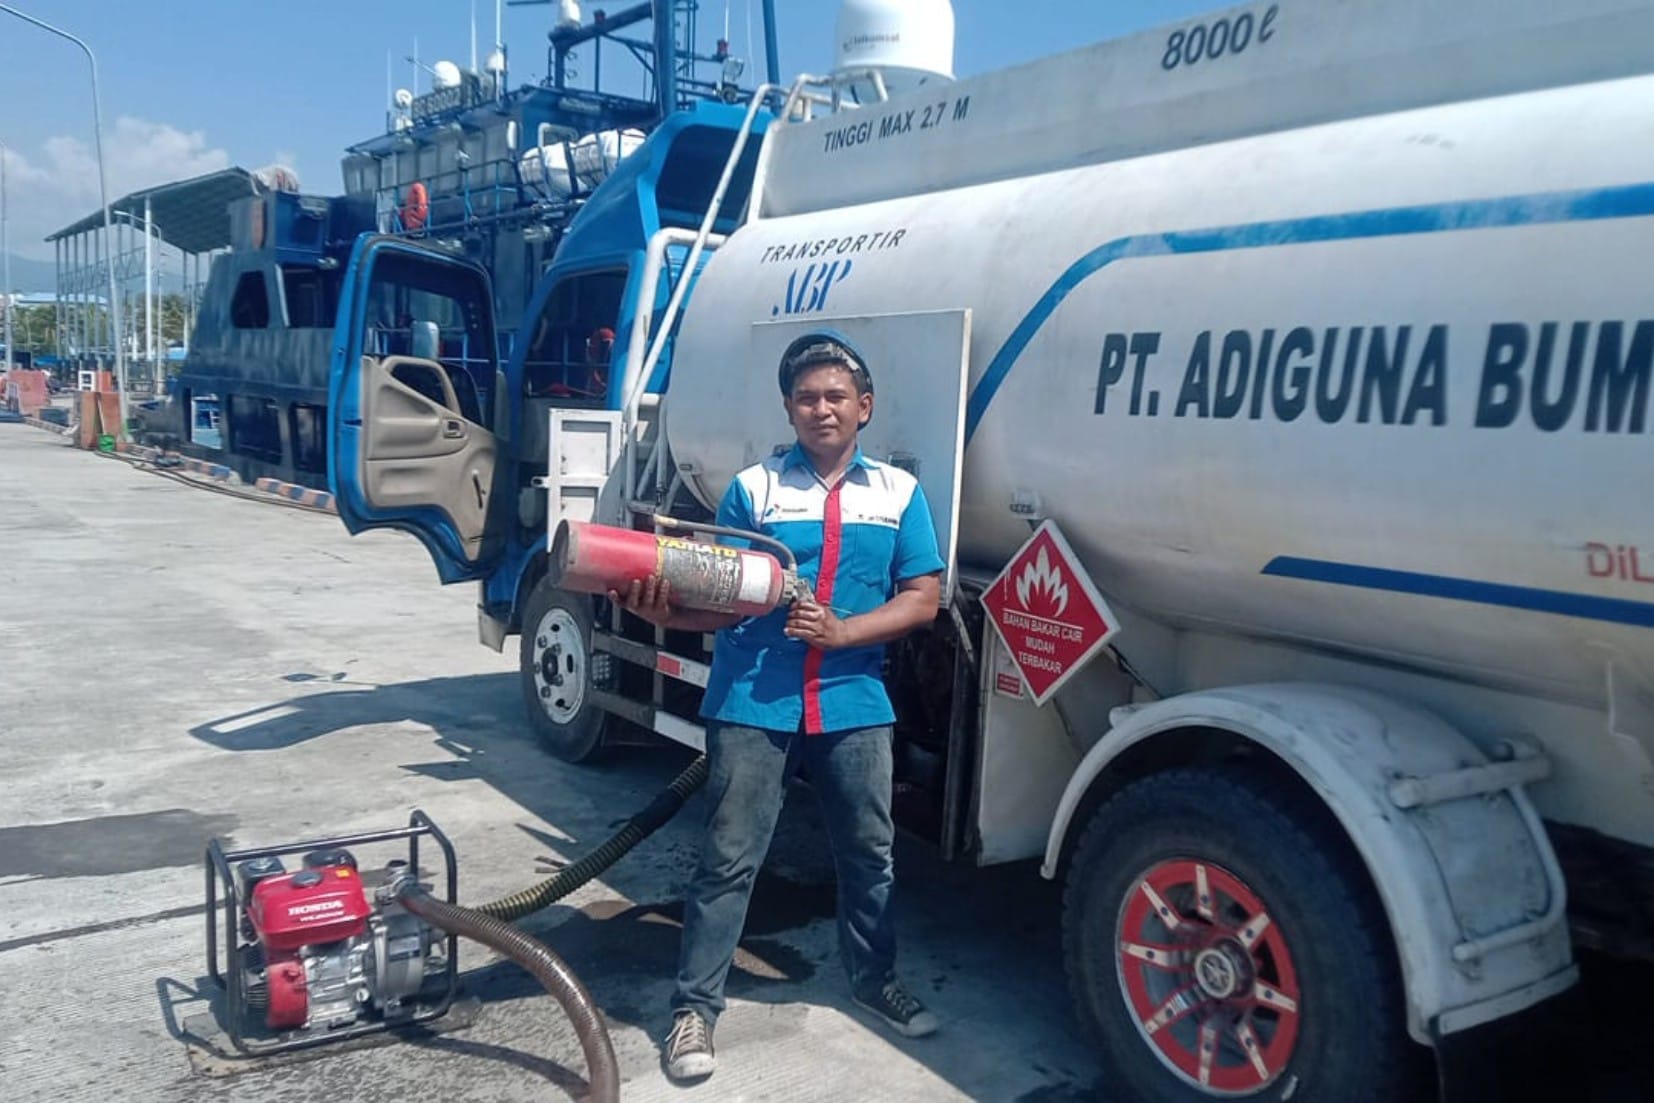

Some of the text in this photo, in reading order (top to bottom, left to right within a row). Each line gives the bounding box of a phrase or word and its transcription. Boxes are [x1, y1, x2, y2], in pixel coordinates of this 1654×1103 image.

[823, 95, 970, 153] TINGGI MAX 2.7 M
[761, 227, 907, 264] TRANSPORTIR
[772, 259, 852, 316] ABP
[1095, 332, 1161, 417] PT.
[1174, 324, 1449, 426] ADIGUNA
[1003, 613, 1083, 643] BAHAN BAKAR CAIR
[1026, 636, 1055, 654] MUDAH
[1018, 651, 1062, 673] TERBAKAR
[288, 900, 344, 915] HONDA
